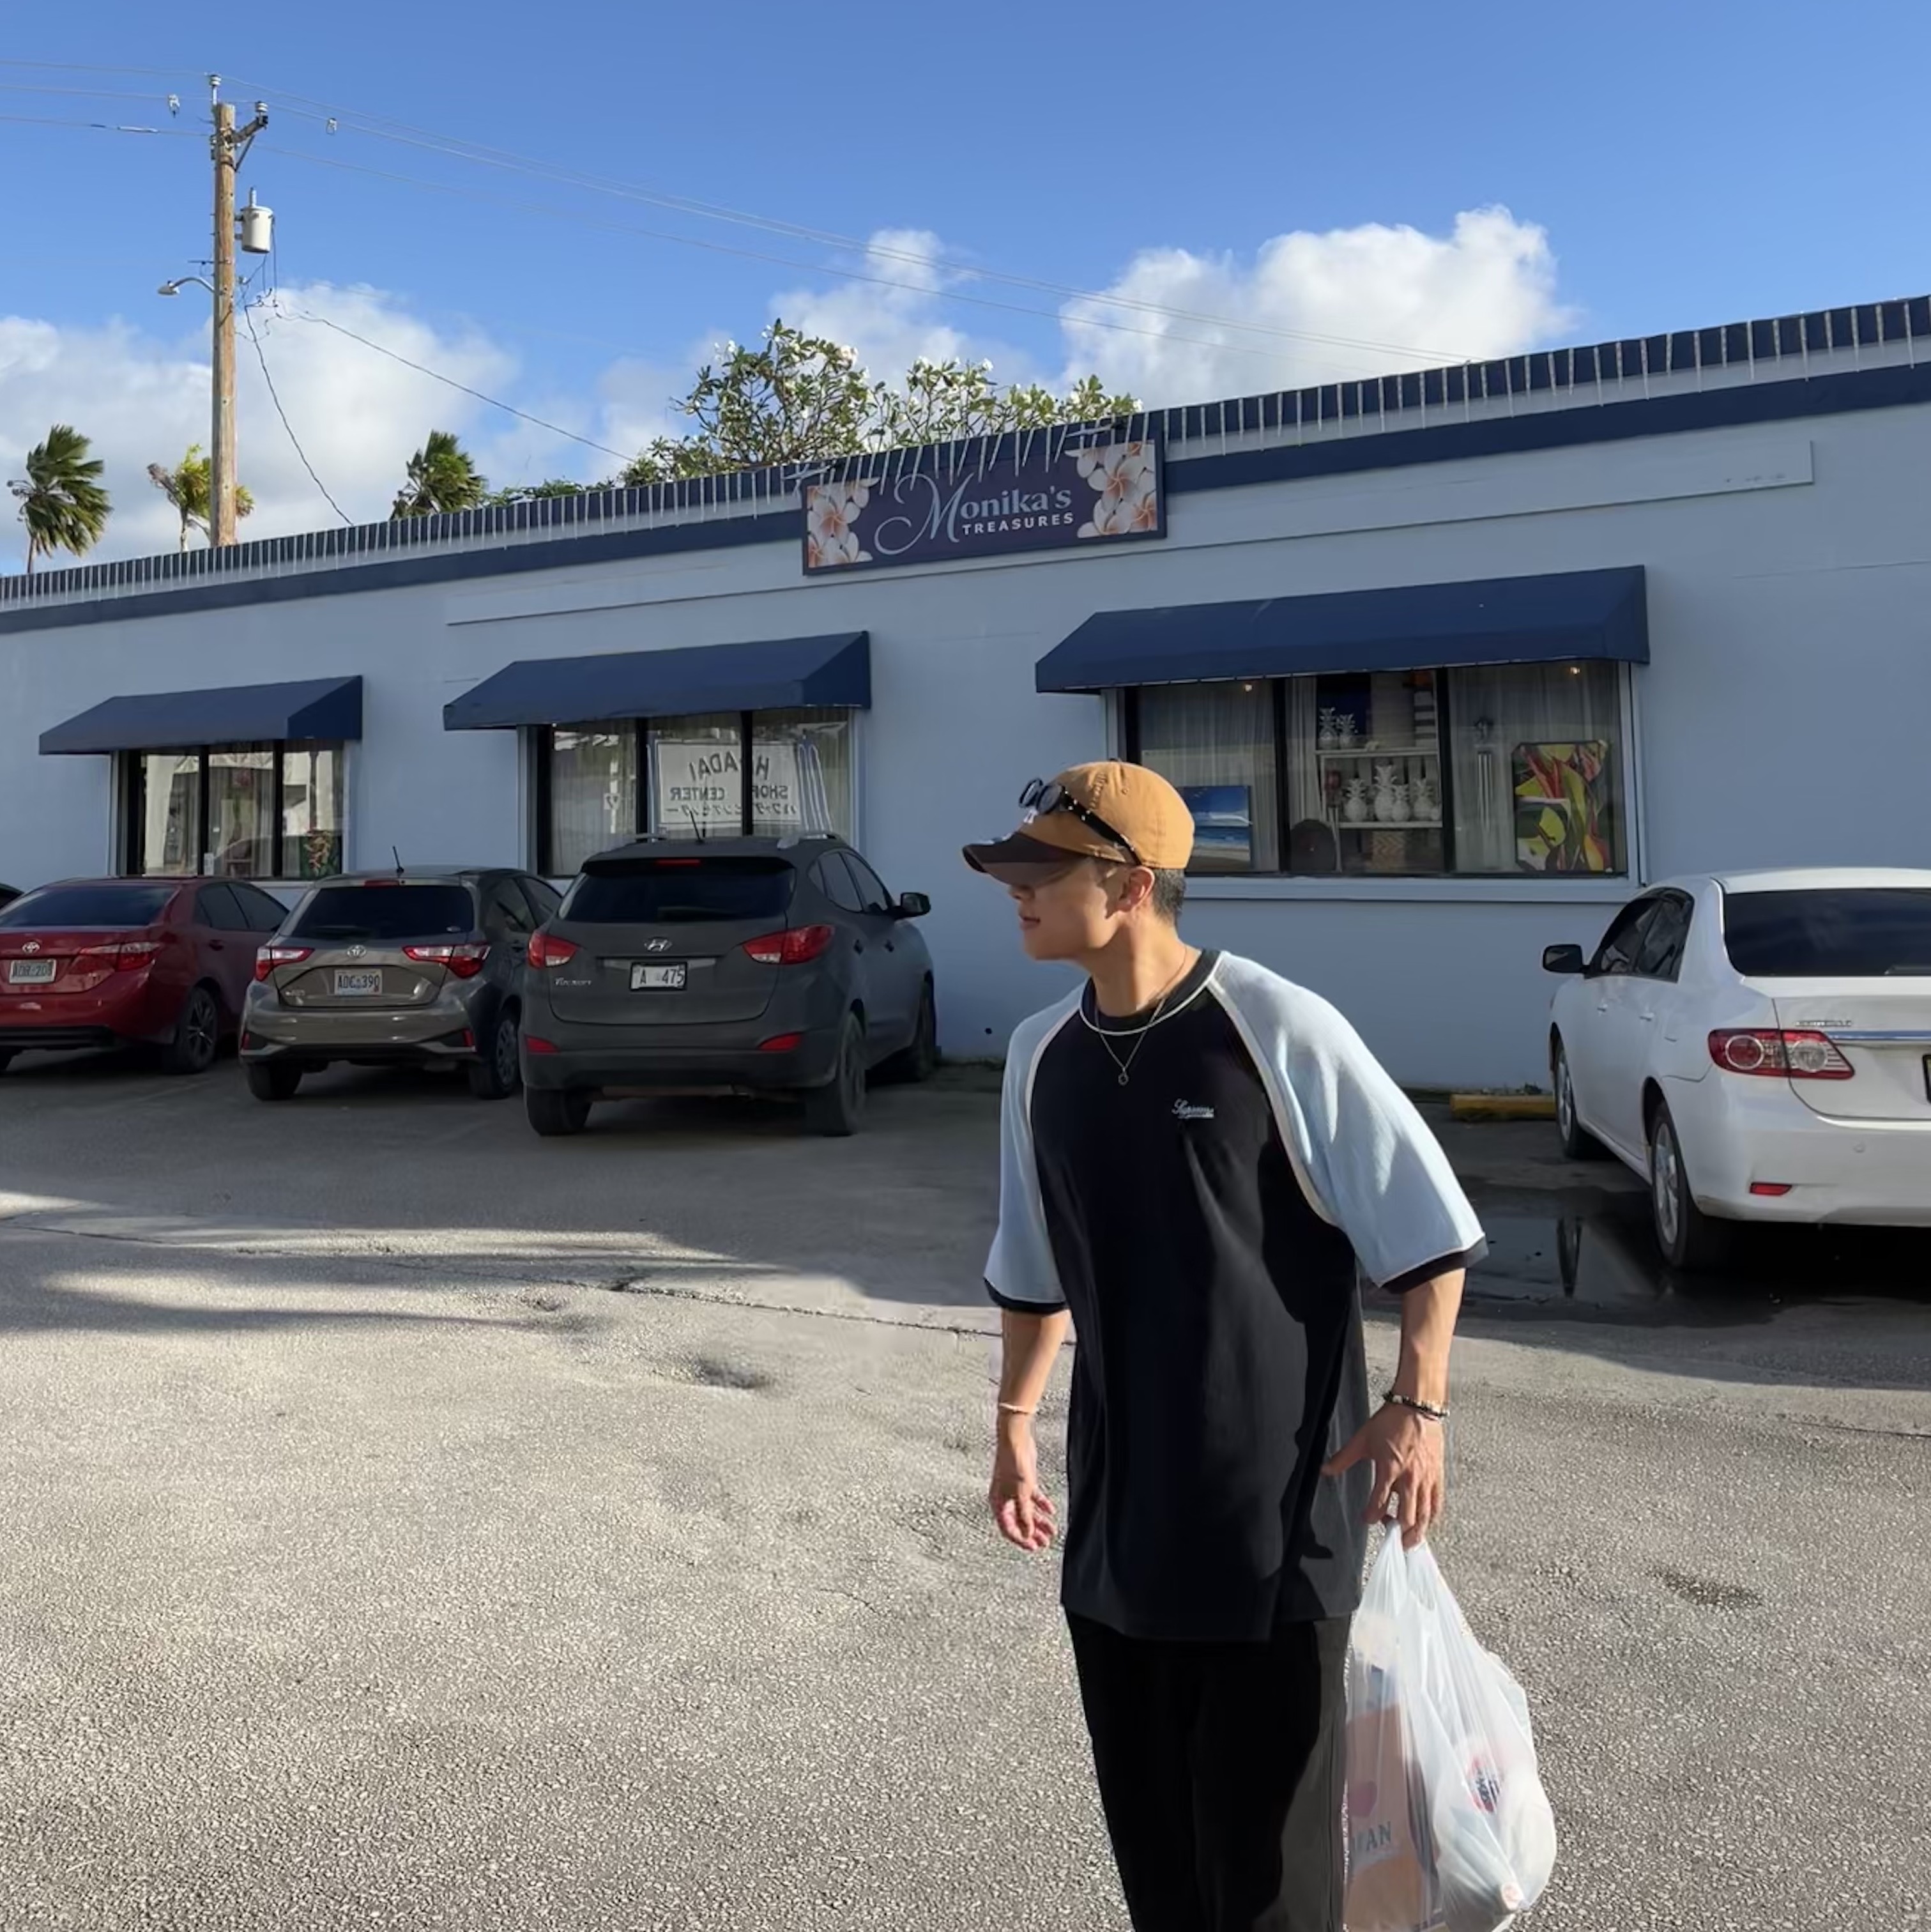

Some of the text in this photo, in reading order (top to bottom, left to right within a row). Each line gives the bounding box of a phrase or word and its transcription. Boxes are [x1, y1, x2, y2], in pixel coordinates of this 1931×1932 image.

[874, 473, 1072, 555] Monika's
[962, 512, 1075, 535] TREASURES
[662, 968, 685, 985] 475
